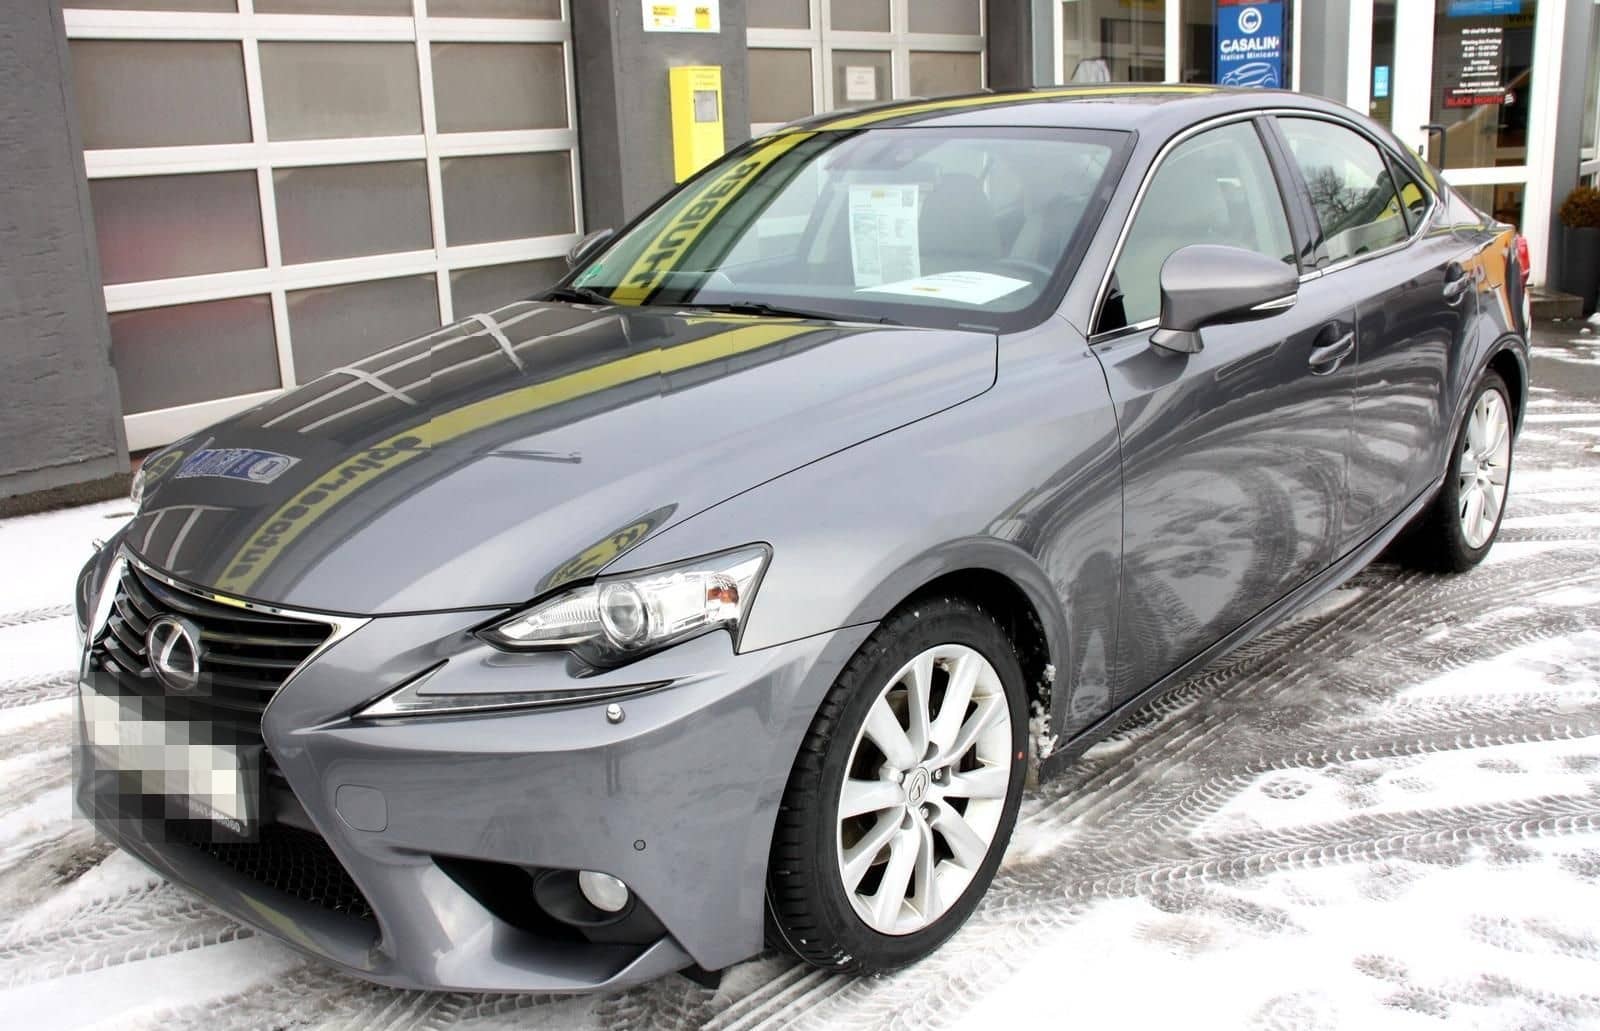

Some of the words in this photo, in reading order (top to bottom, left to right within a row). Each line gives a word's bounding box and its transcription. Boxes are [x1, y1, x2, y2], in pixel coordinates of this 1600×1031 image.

[1220, 54, 1245, 62] Italian
[1247, 51, 1279, 60] Minicars
[1448, 95, 1473, 106] BLACK
